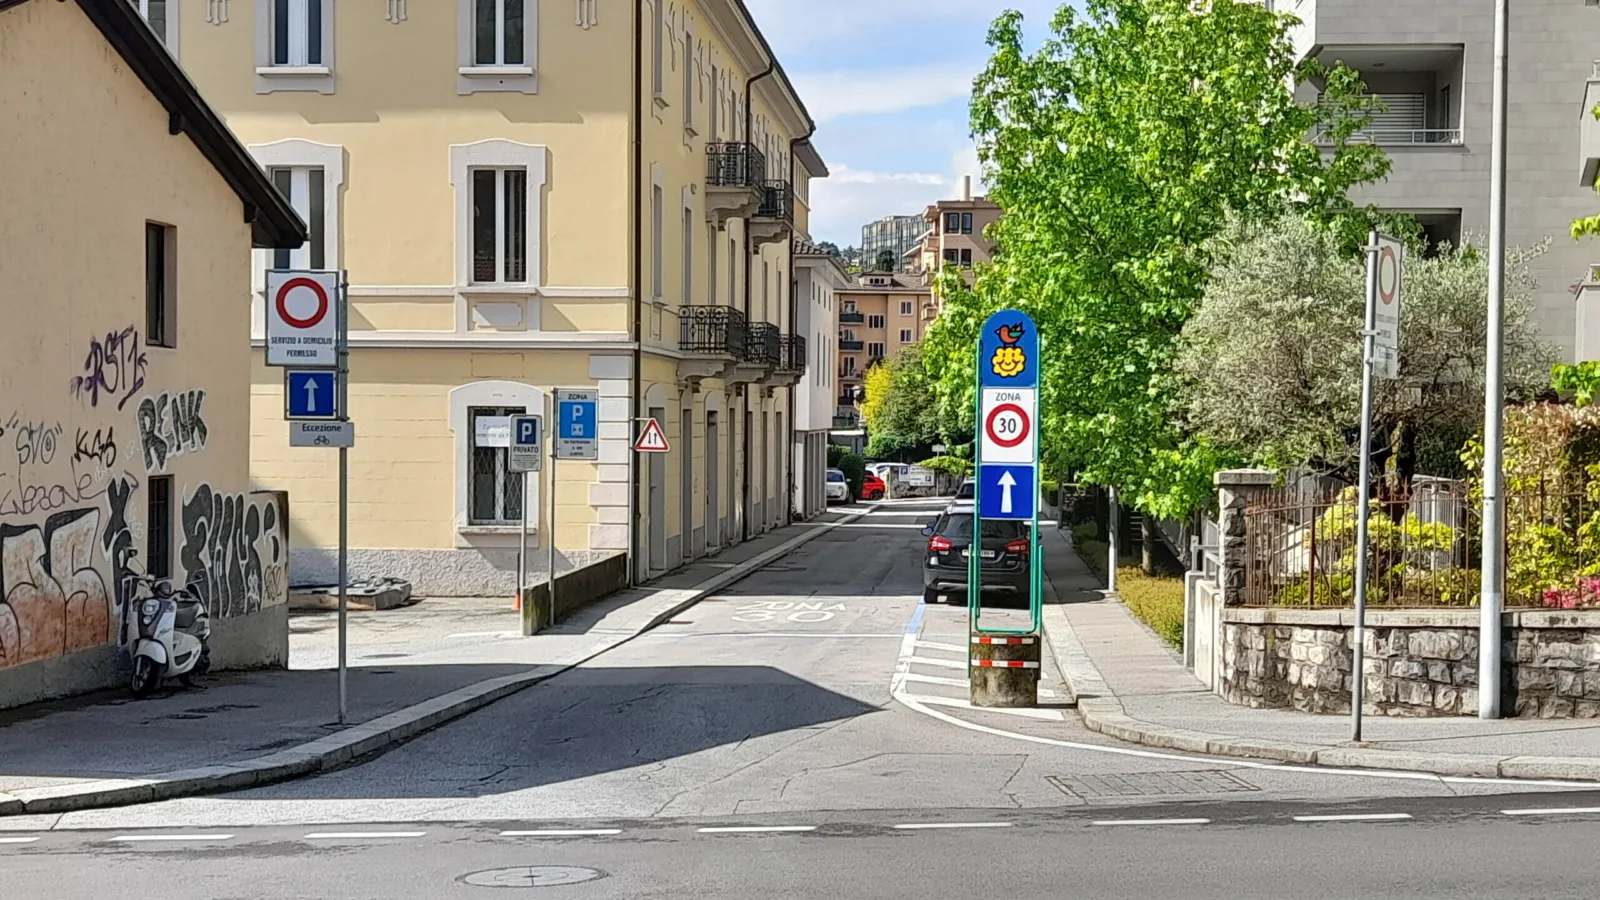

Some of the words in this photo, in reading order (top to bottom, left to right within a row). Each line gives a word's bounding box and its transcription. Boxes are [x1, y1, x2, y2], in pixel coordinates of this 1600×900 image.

[303, 337, 333, 345] DOMICILIO
[995, 393, 1021, 401] ZONA
[302, 424, 342, 432] Eccezione
[998, 418, 1017, 434] 30
[736, 601, 846, 611] ZONA
[731, 610, 836, 622] 30
